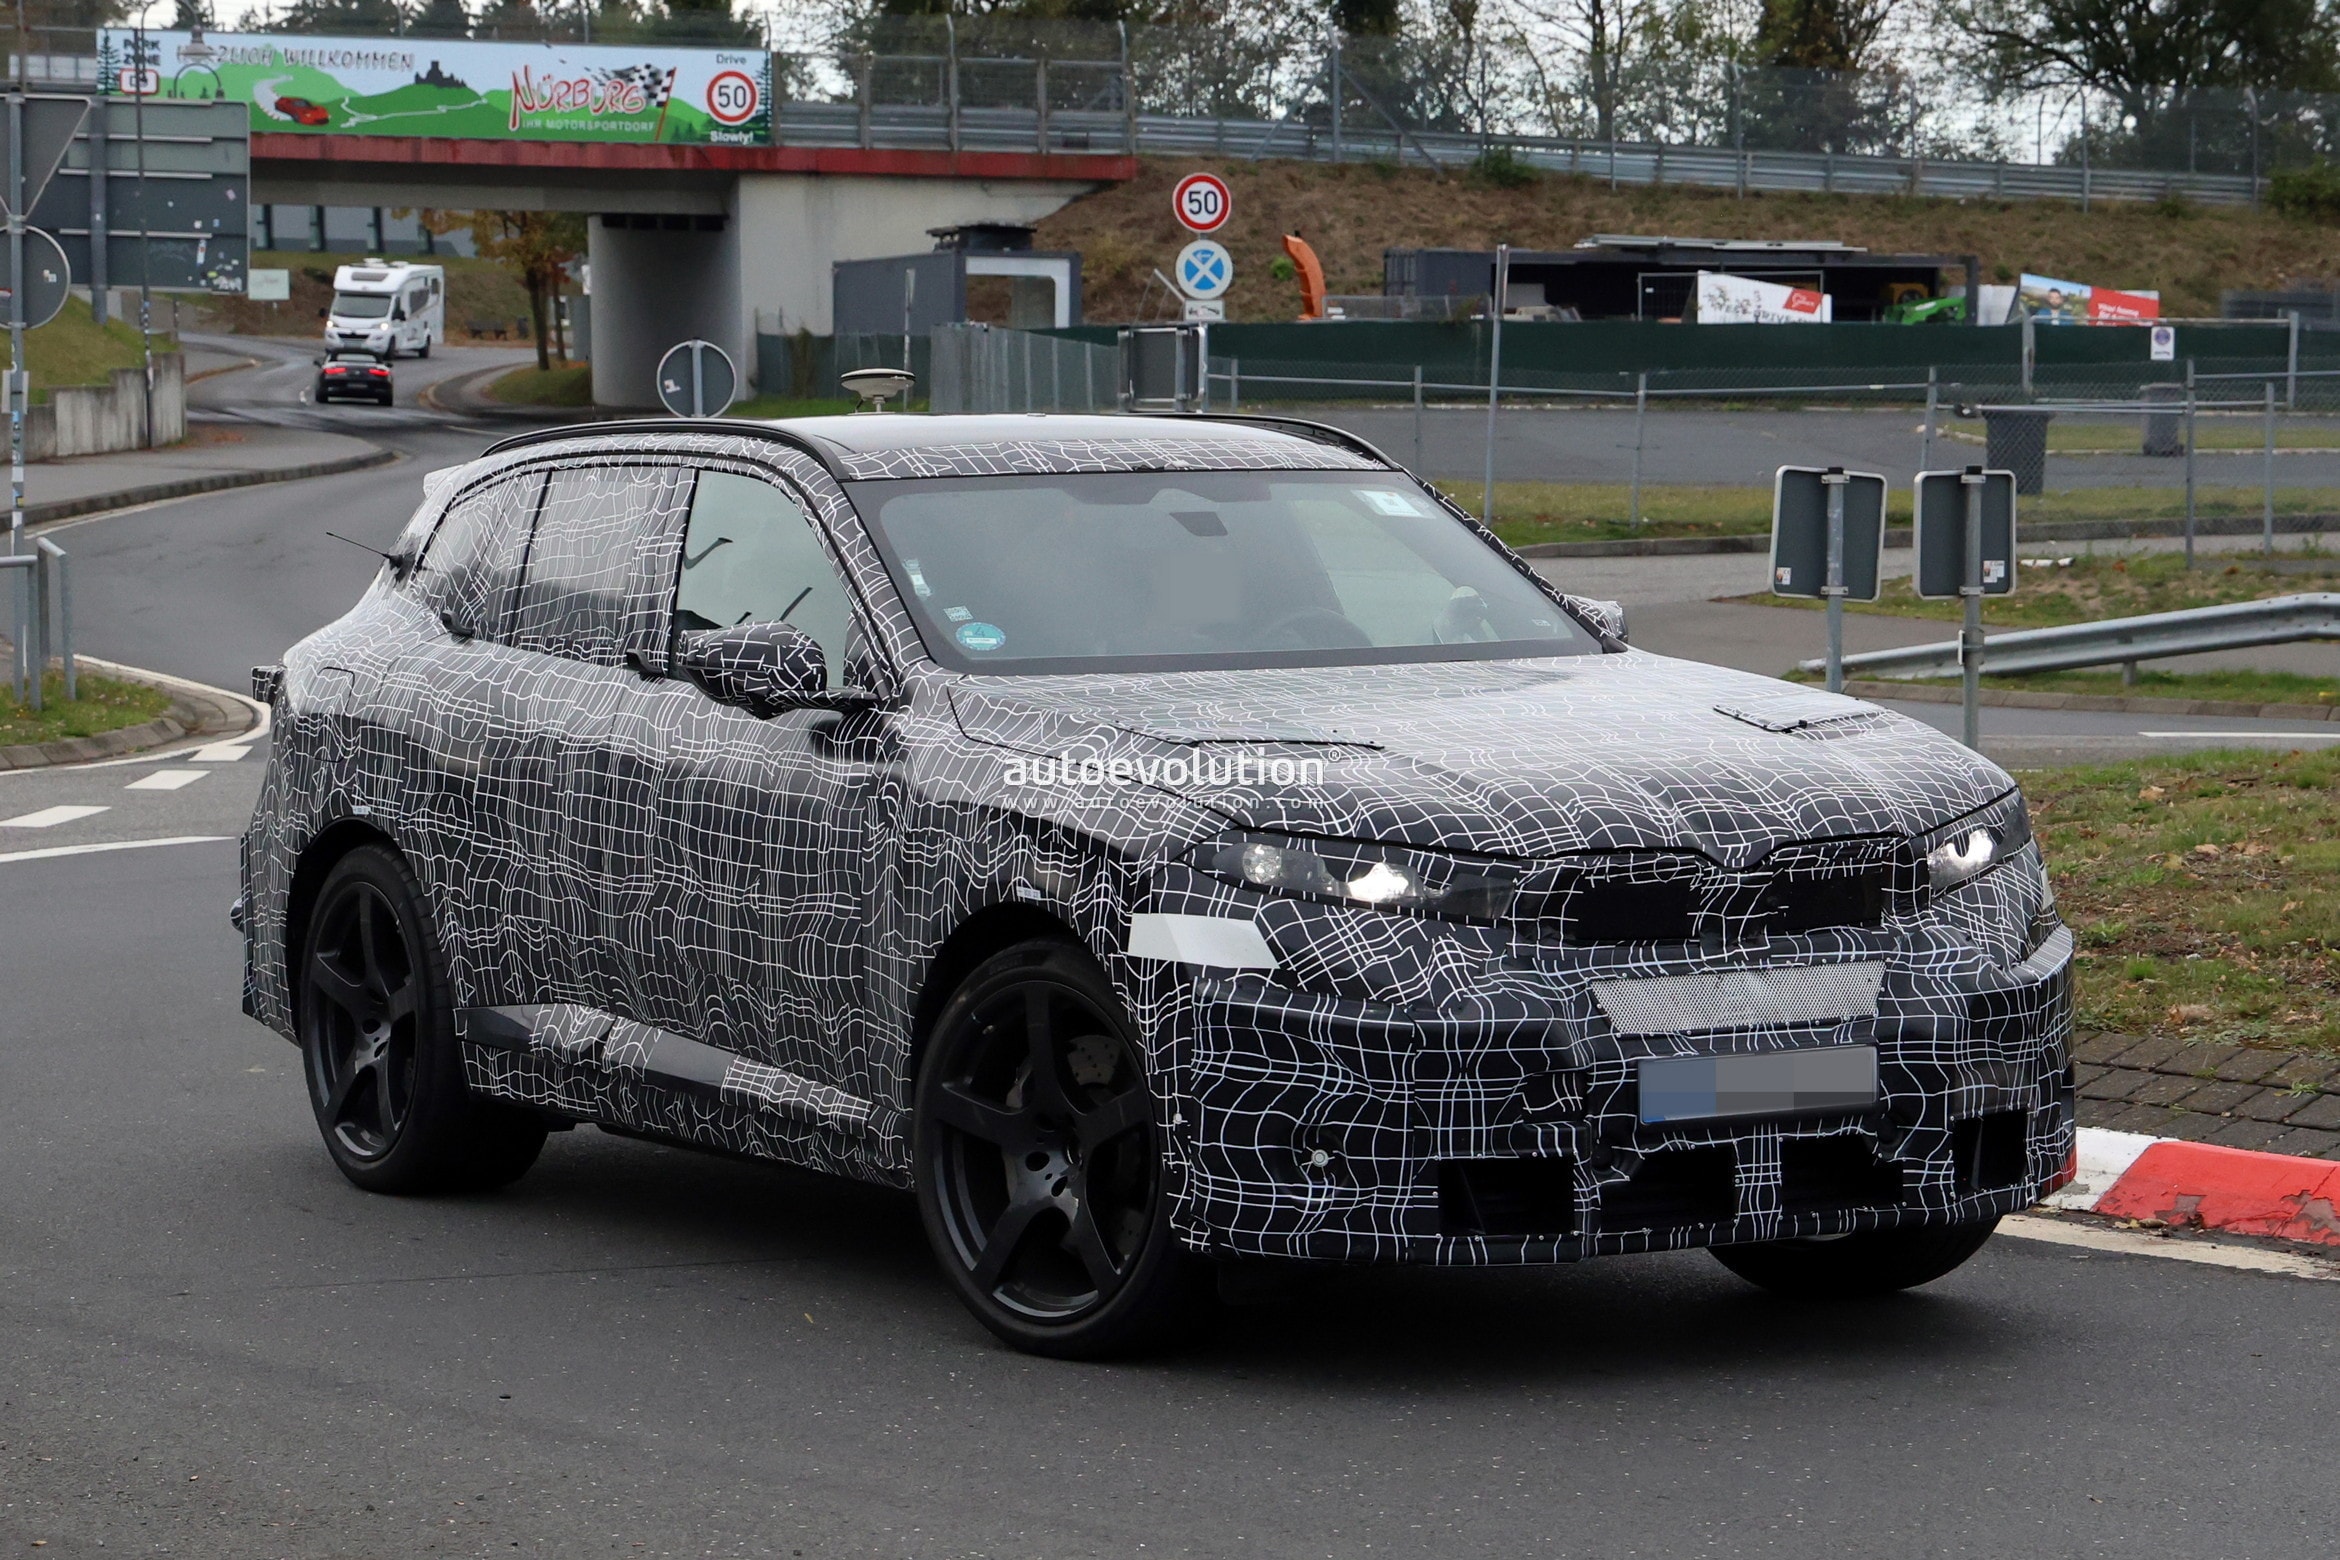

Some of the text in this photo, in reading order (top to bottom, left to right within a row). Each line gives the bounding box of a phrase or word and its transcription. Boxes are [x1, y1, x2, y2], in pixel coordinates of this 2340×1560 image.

[284, 48, 415, 71] WILLKOMMEN
[716, 53, 747, 65] Drive
[718, 85, 747, 108] 50
[522, 119, 656, 133] IHR MOTORSPORTDORF
[710, 130, 754, 145] Slowly!
[1188, 190, 1218, 215] 50
